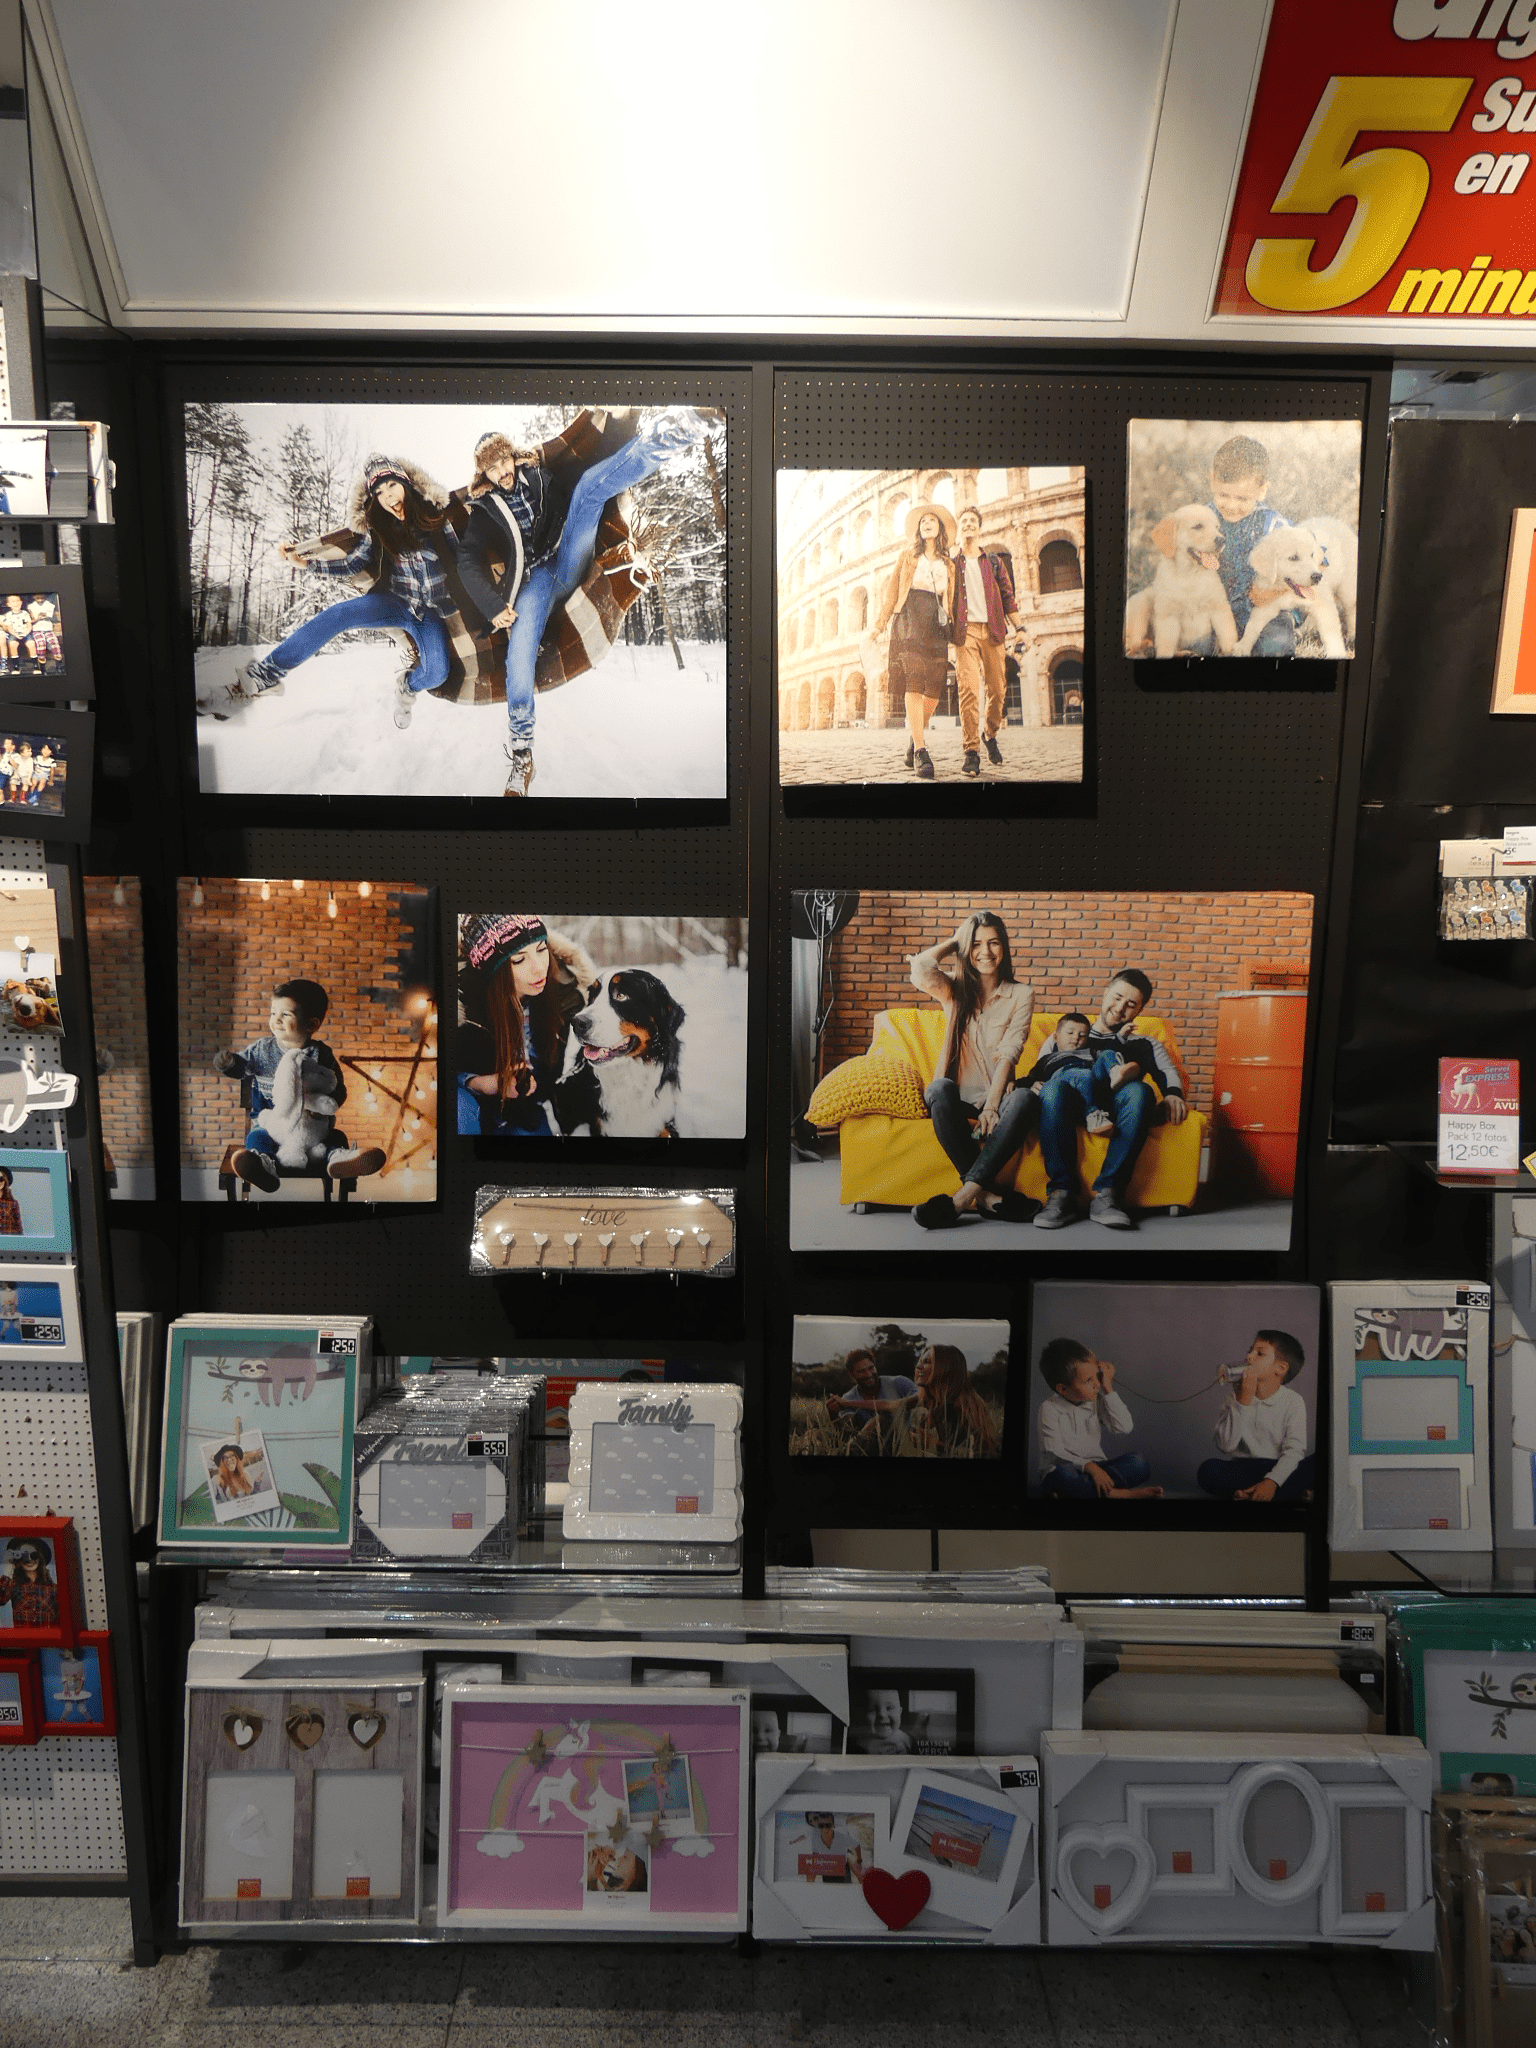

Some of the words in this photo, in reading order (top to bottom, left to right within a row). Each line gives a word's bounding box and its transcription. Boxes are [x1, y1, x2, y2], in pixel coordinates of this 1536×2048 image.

[1453, 152, 1531, 195] en
[1245, 75, 1475, 312] 5
[1464, 1071, 1510, 1083] EXPRESS
[1447, 1120, 1477, 1132] Happy
[1479, 1121, 1496, 1130] Box
[1447, 1131, 1469, 1141] Pack
[1472, 1132, 1482, 1142] 12
[1484, 1133, 1507, 1142] fotos
[1447, 1143, 1499, 1161] 12,50€
[1466, 1292, 1489, 1307] 1250
[34, 1325, 60, 1340] 1250
[331, 1339, 355, 1353] 1250
[618, 1397, 695, 1434] Family
[391, 1434, 470, 1469] Friend
[483, 1441, 505, 1455] 650
[1015, 1771, 1037, 1787] 750
